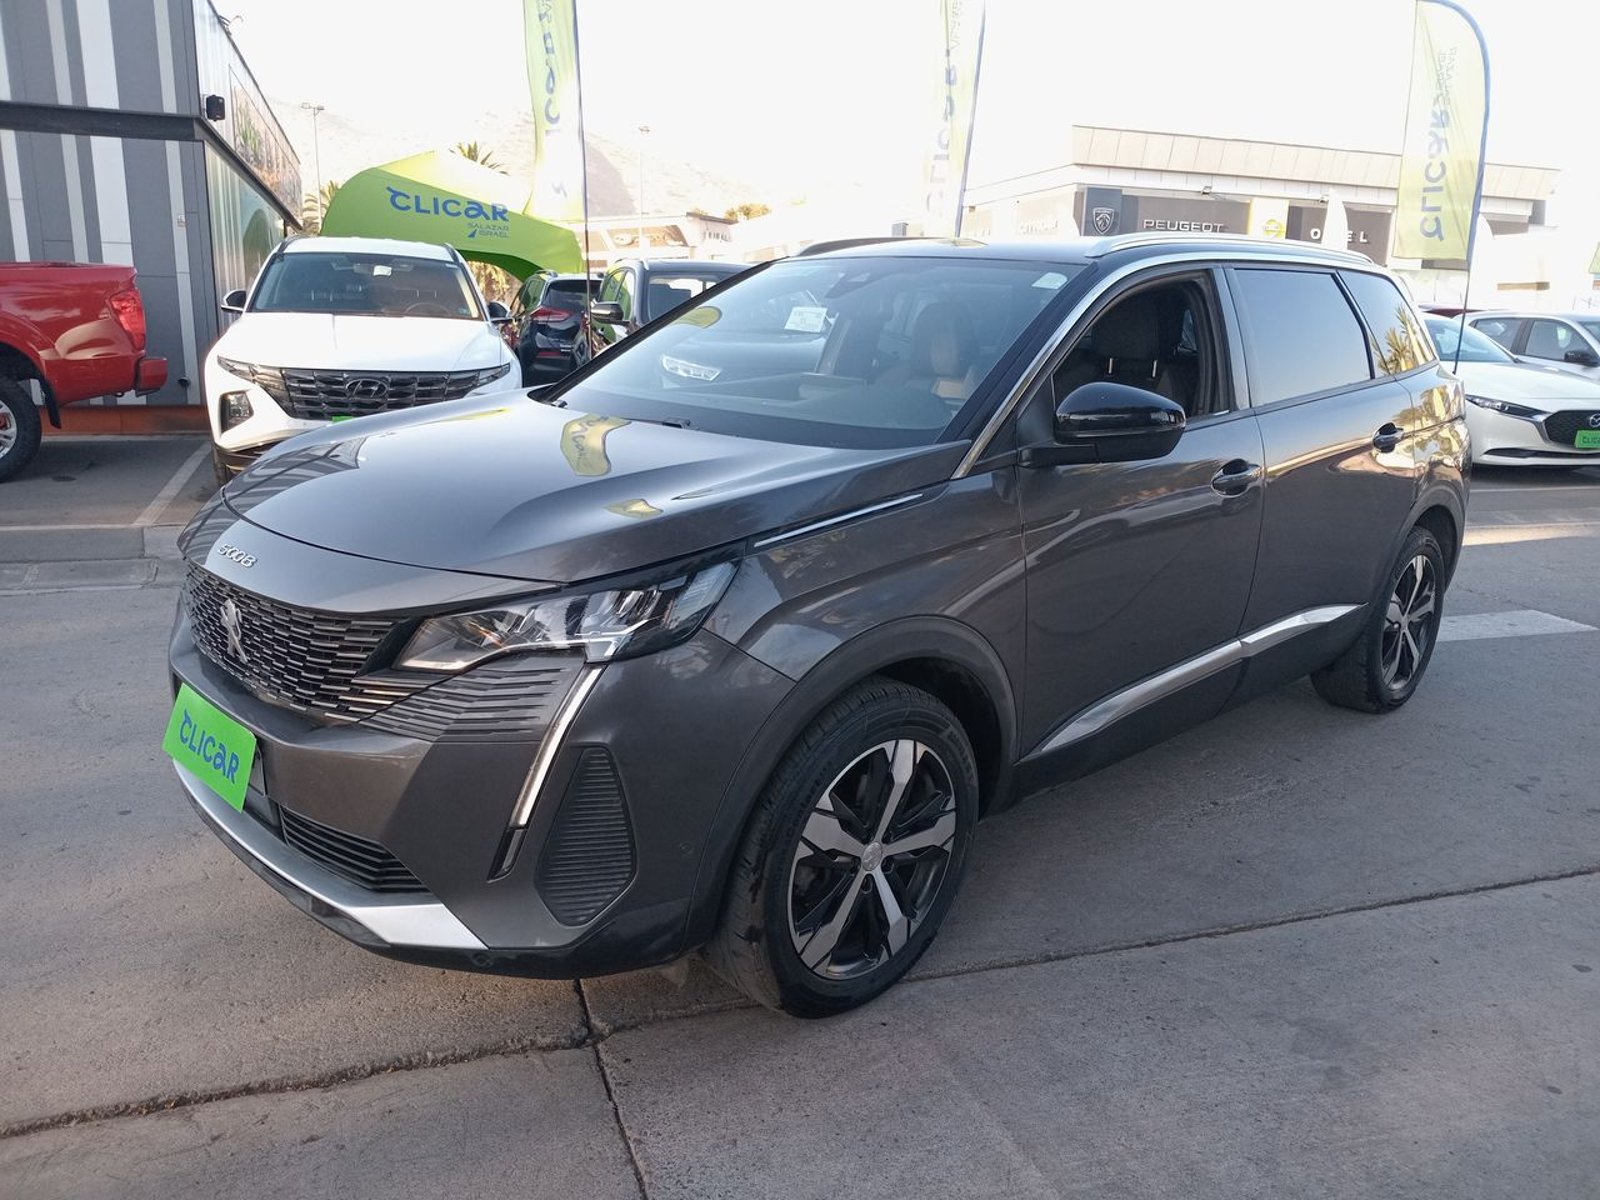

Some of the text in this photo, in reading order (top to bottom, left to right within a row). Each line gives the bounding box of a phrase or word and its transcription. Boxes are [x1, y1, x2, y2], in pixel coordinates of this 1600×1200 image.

[1143, 219, 1224, 233] PEUGEOT
[1310, 228, 1368, 243] OEL
[218, 544, 257, 567] 5008
